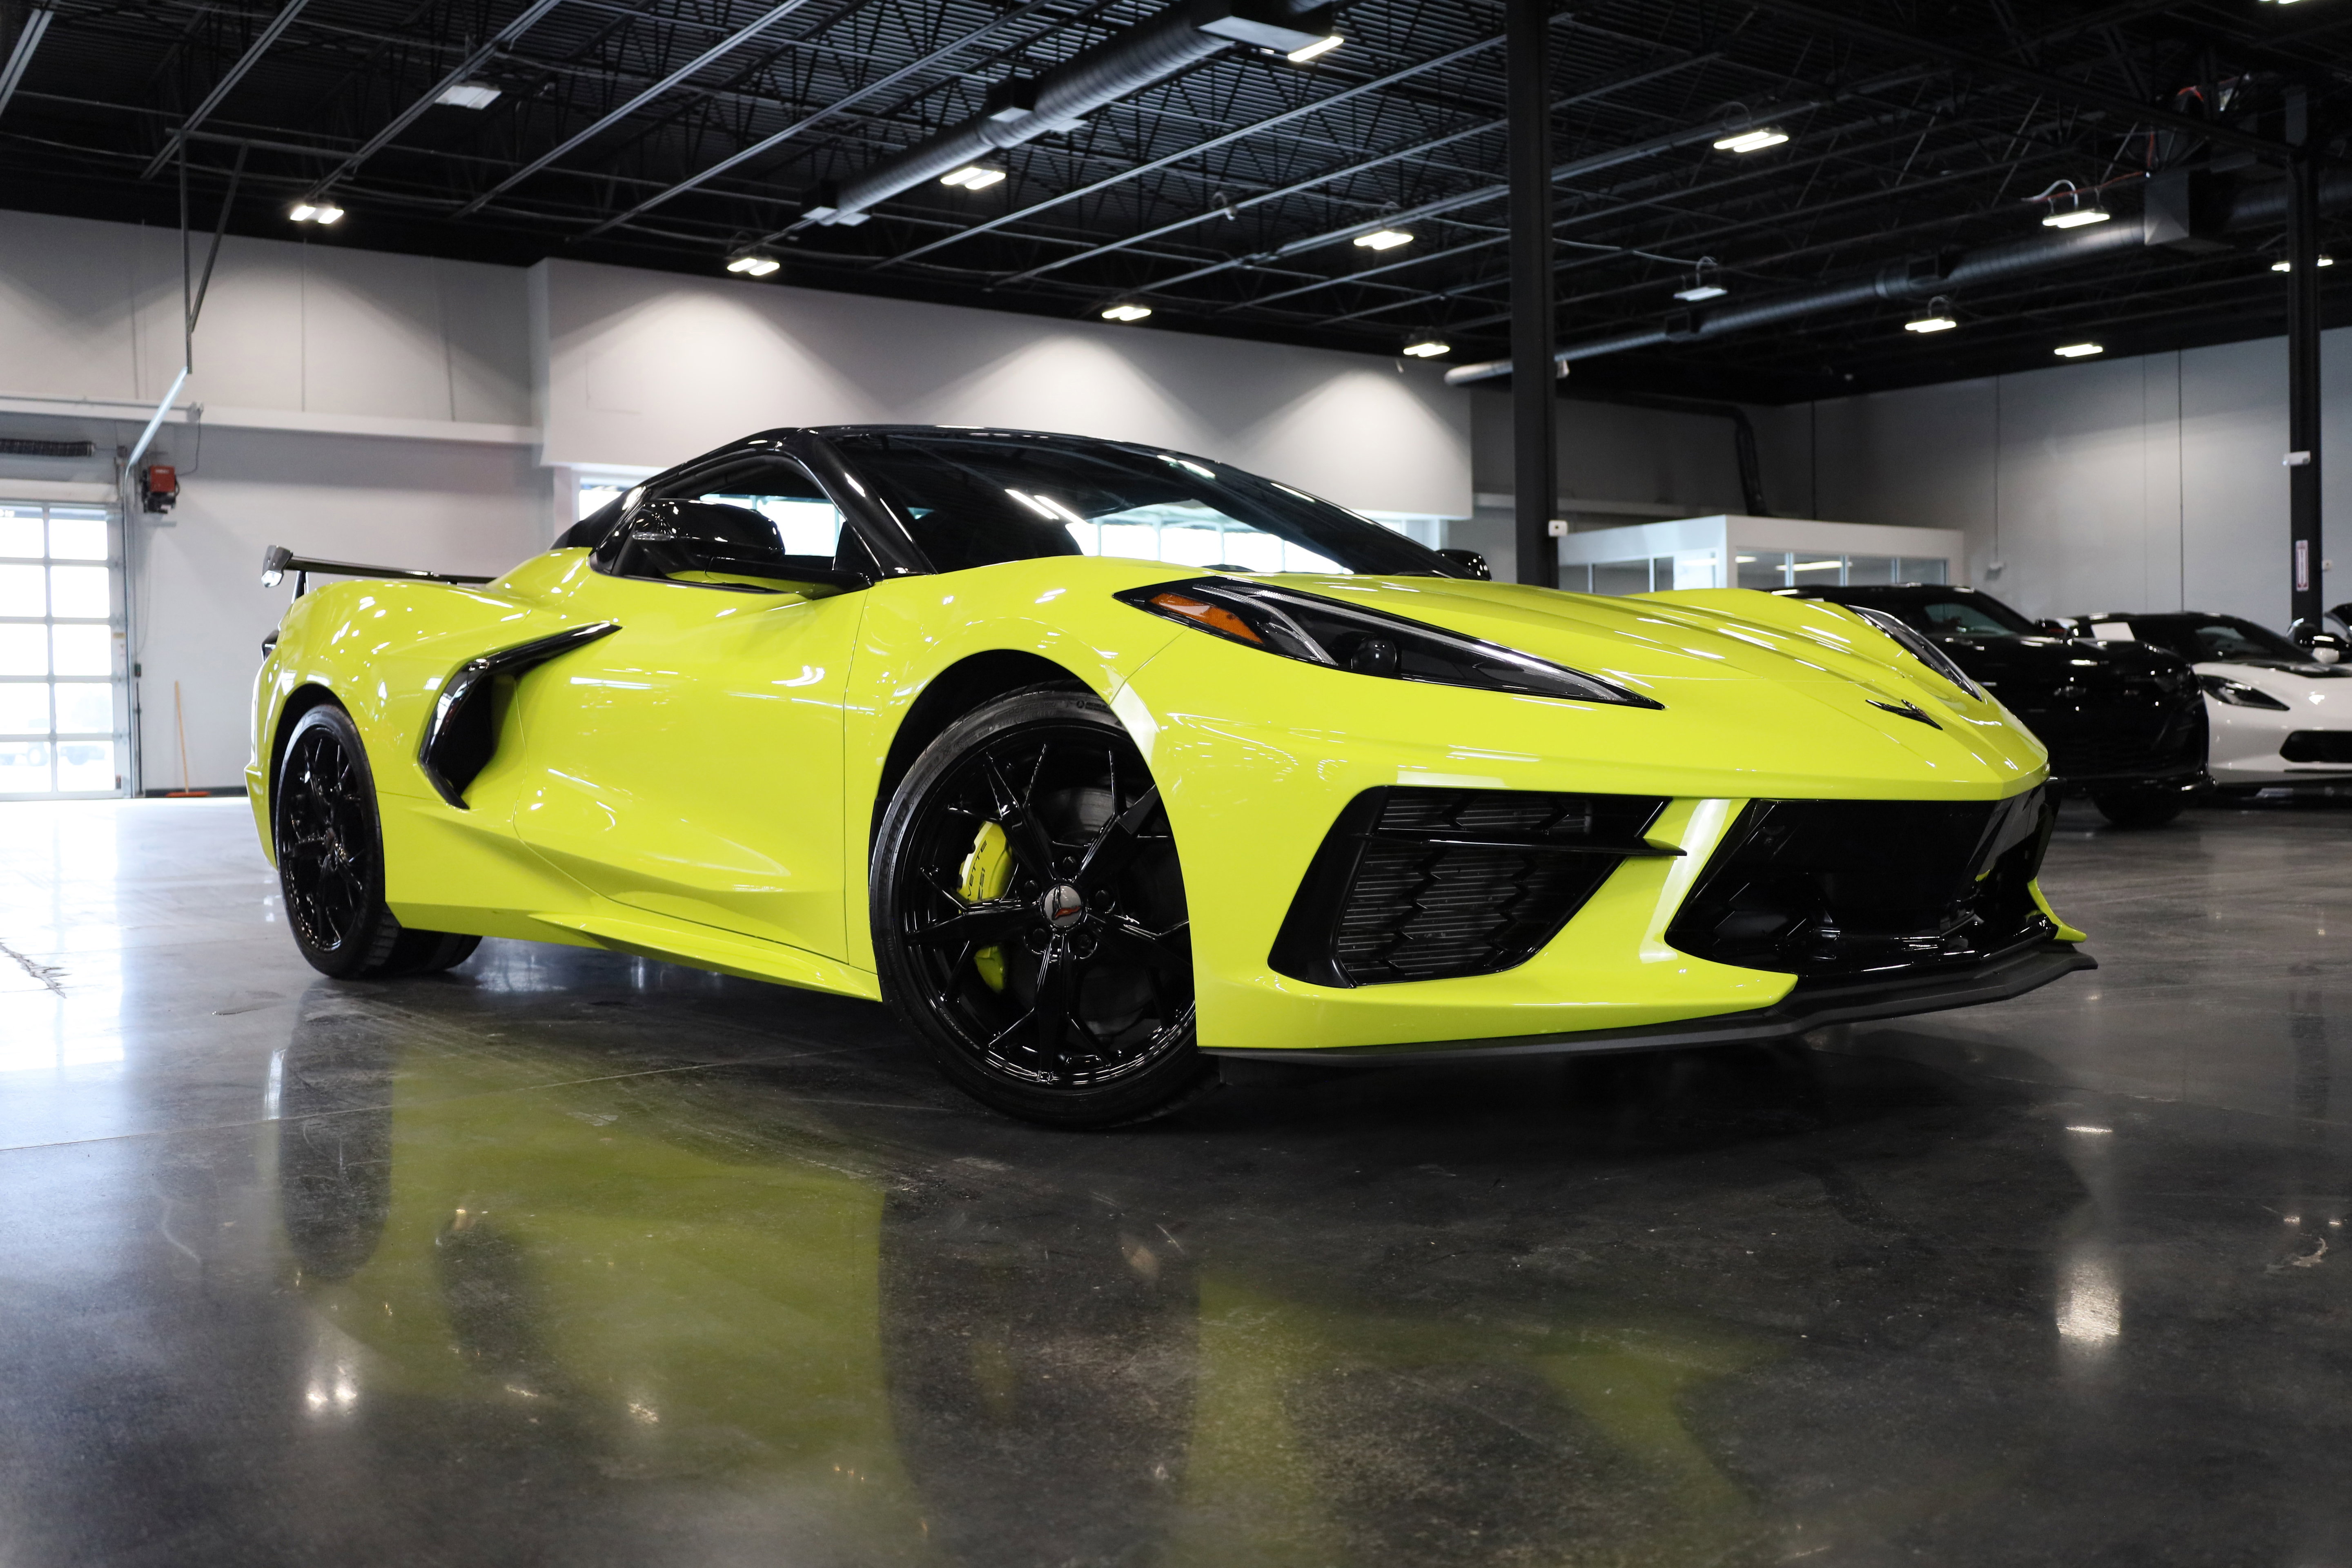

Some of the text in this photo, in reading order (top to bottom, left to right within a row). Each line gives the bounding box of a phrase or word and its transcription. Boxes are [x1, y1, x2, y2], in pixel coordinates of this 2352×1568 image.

[967, 840, 987, 900] VETTE
[978, 867, 986, 900] Z51
[940, 1007, 980, 1050] CORVETTE
